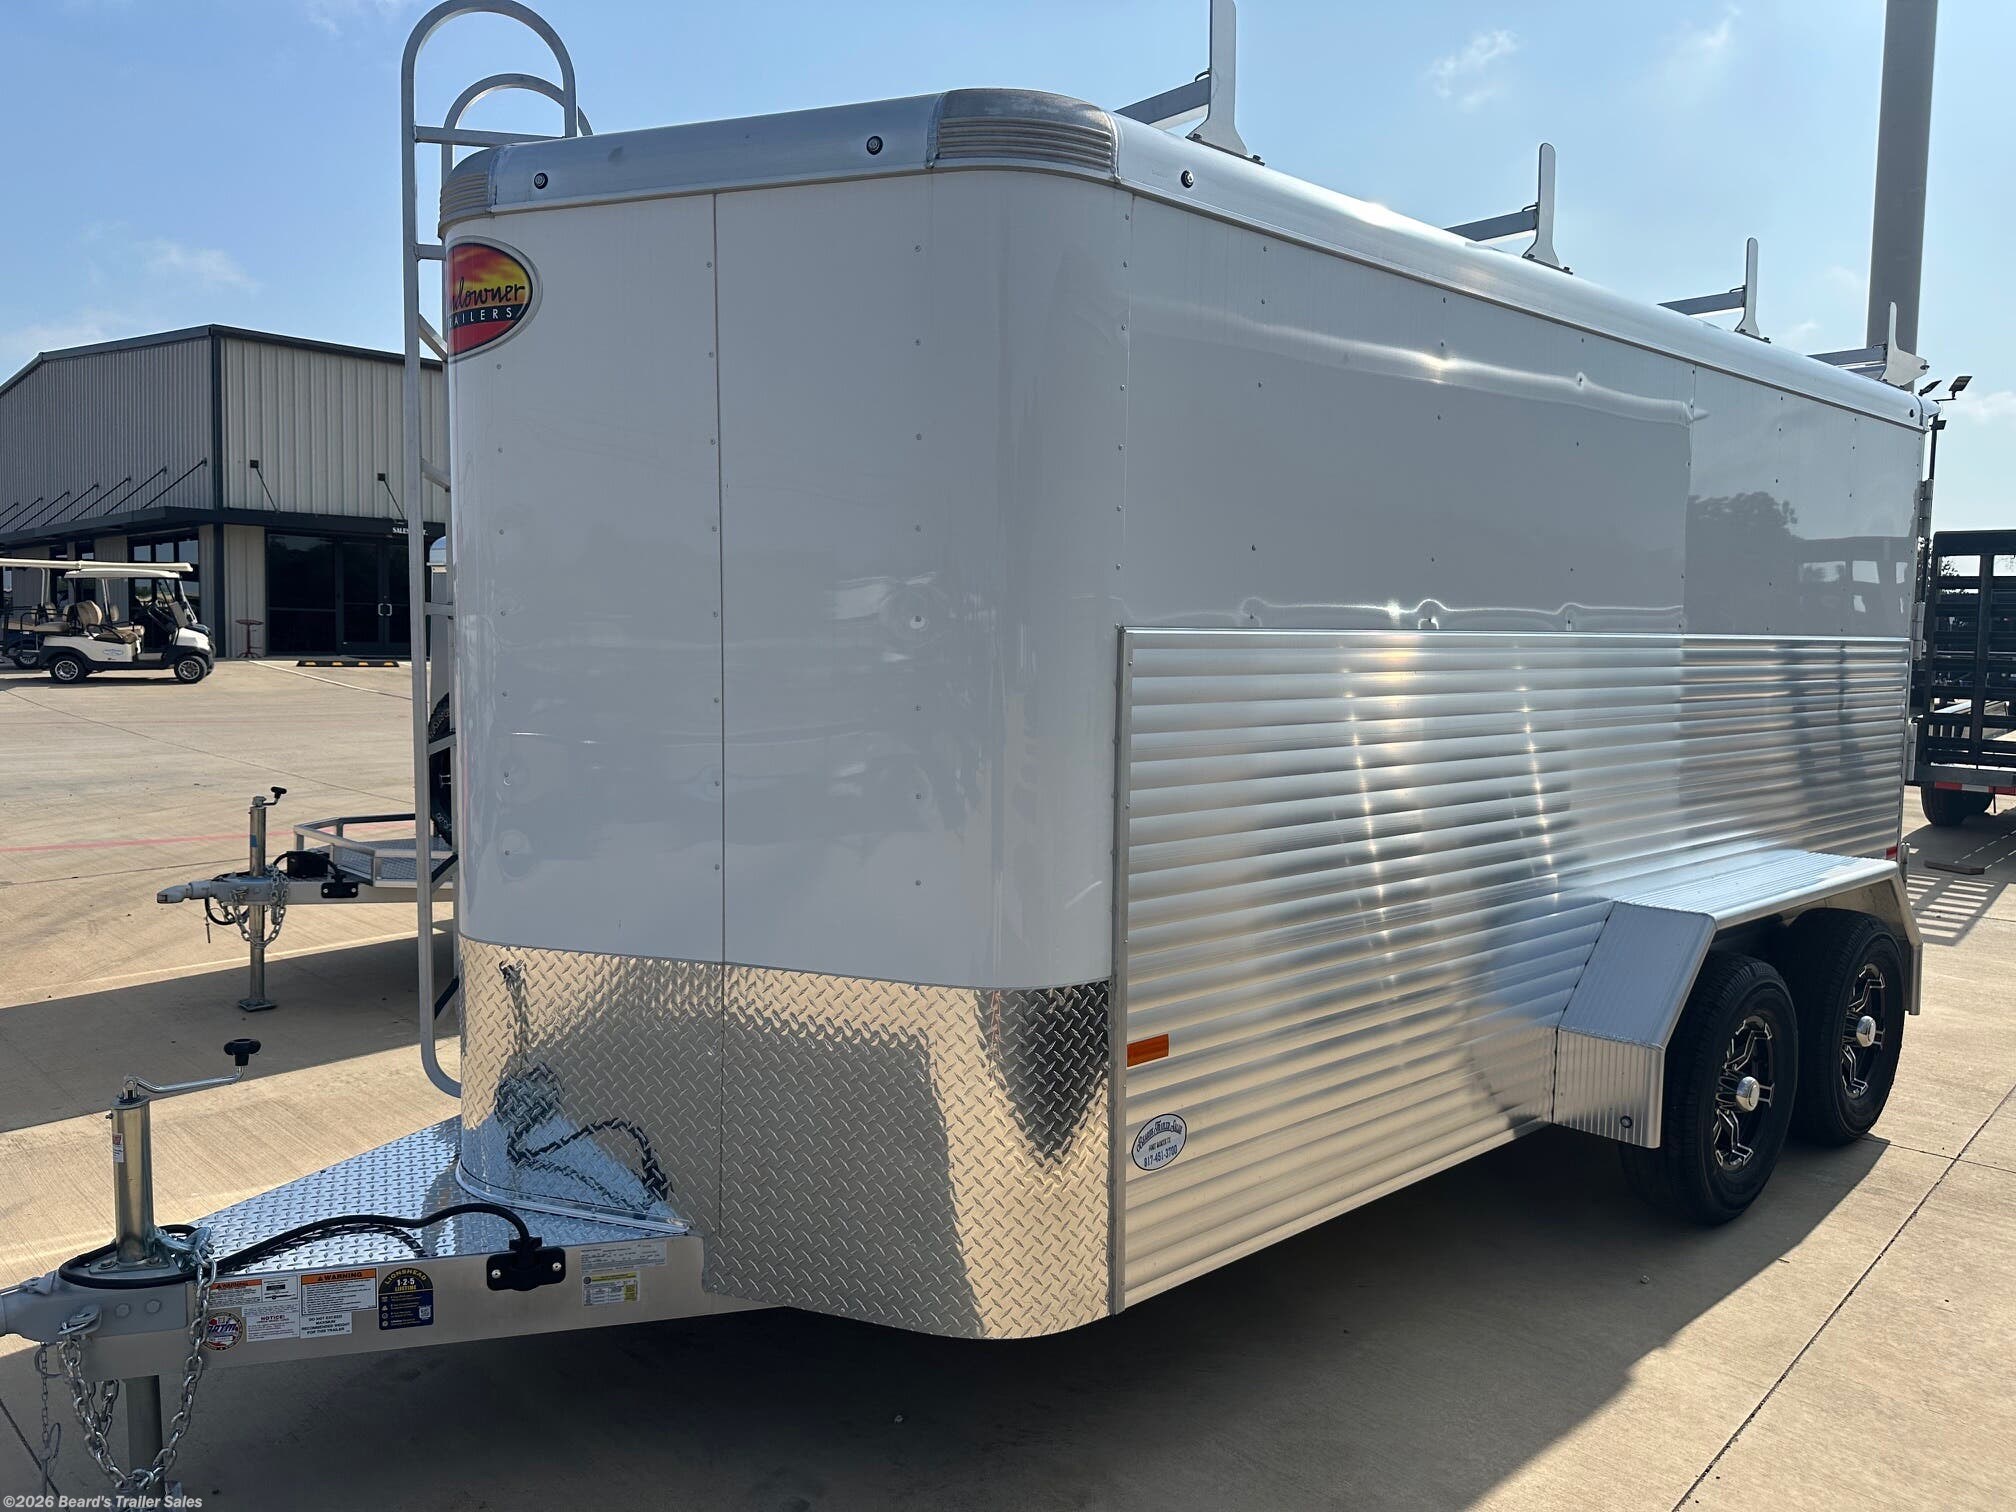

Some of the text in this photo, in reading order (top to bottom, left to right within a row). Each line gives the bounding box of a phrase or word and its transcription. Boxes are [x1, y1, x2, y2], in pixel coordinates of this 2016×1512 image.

[449, 307, 512, 328] AILERS
[324, 1271, 363, 1281] WARNING
[384, 1269, 427, 1285] LIONSHEAD
